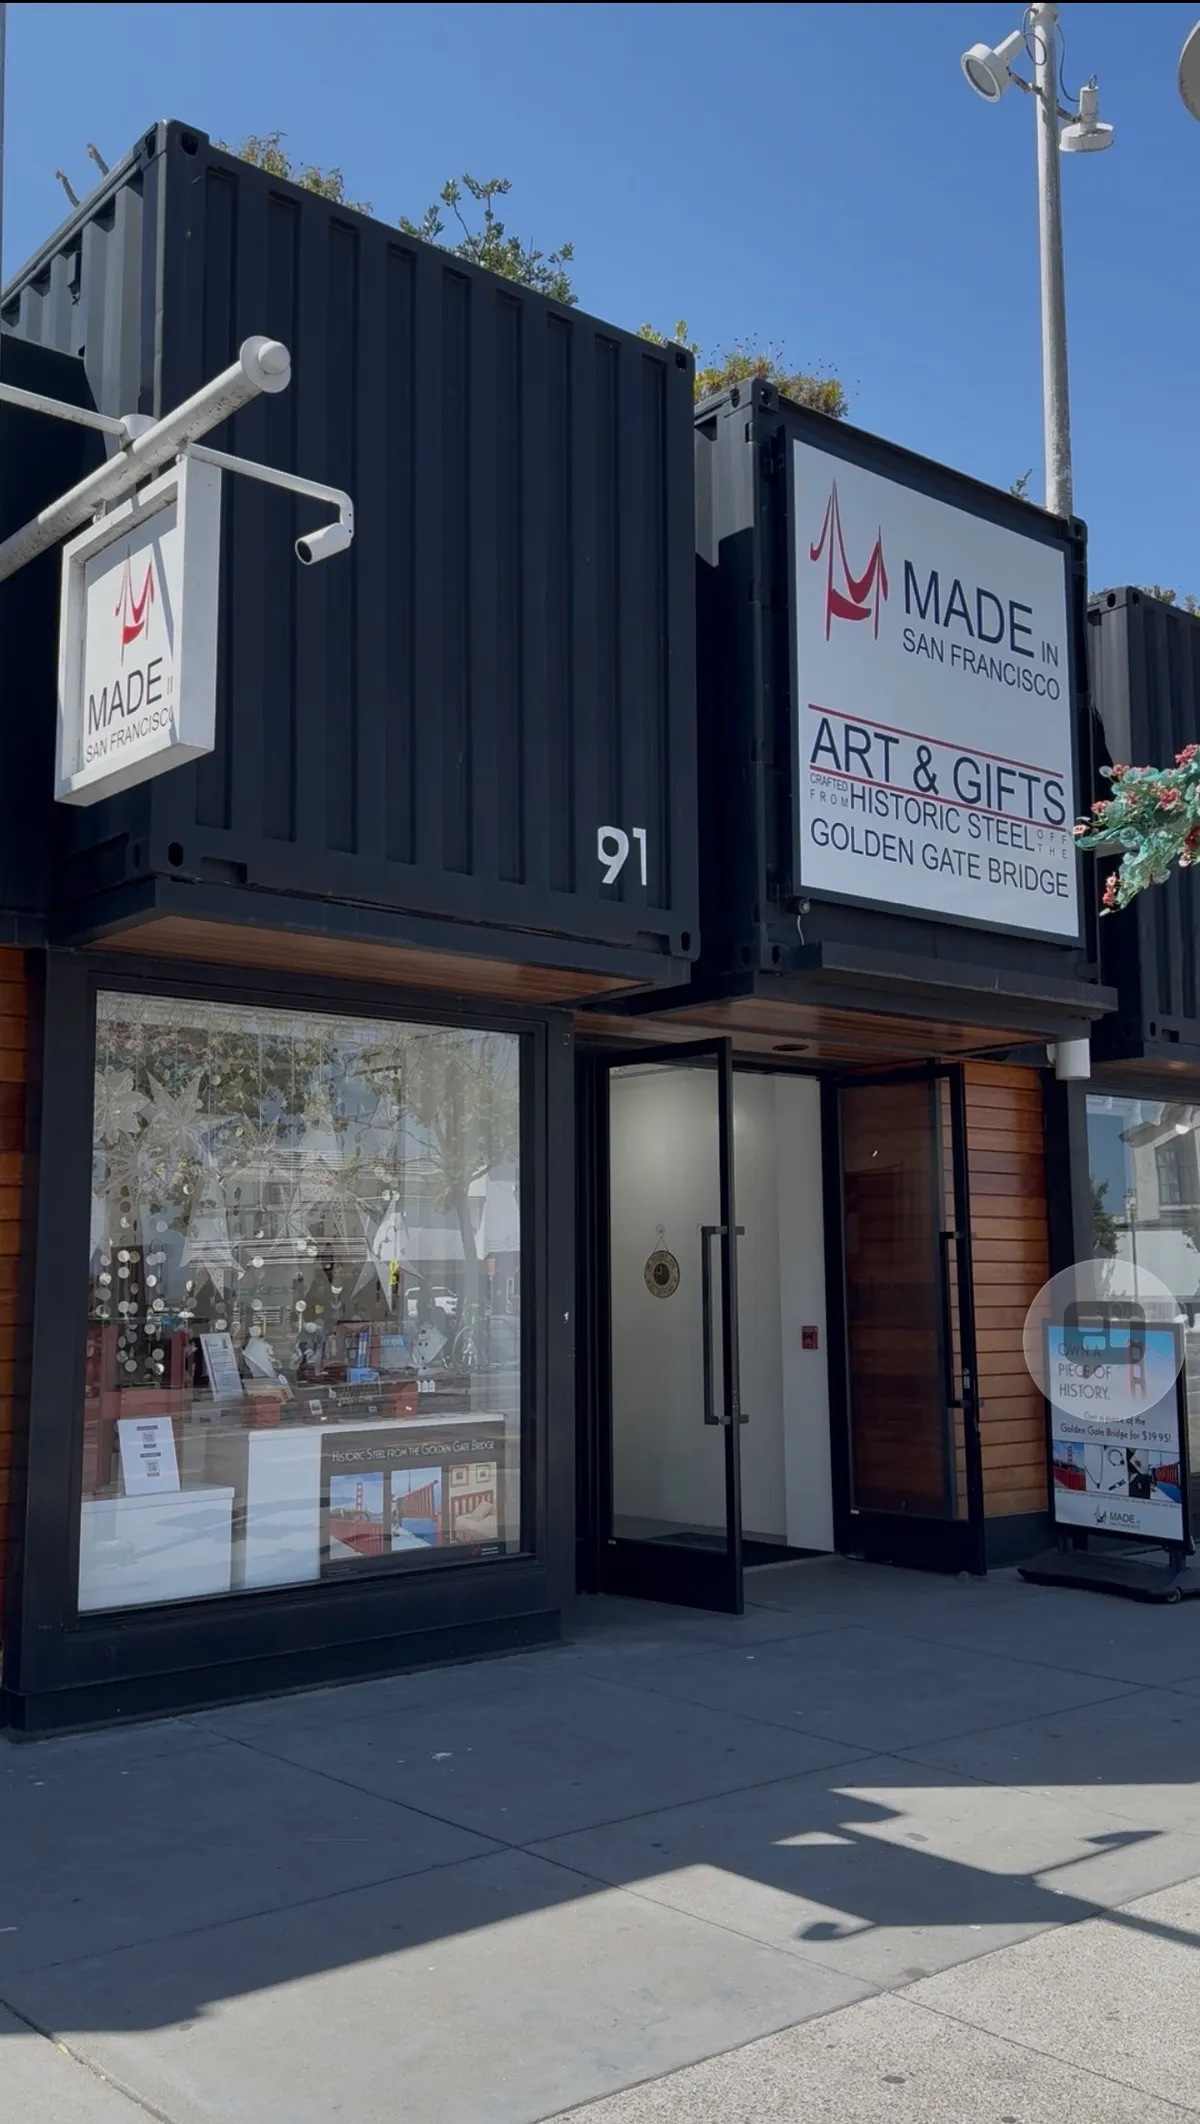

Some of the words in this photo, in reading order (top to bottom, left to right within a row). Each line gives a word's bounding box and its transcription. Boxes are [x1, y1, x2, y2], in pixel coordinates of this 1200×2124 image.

[904, 559, 1035, 659] MADE
[1041, 641, 1059, 668] IN
[902, 628, 944, 663] SAN
[951, 644, 1060, 700] FRANCISCO
[88, 657, 163, 735] MADE
[86, 737, 108, 763] SAN
[810, 717, 899, 783] ART
[913, 744, 940, 795] &
[953, 756, 1067, 825] GIFTS
[810, 772, 848, 792] CRAFTED
[810, 788, 849, 808] FROM
[850, 782, 961, 835] HISTORIC
[967, 813, 1036, 853] STEEL
[1037, 829, 1068, 845] OFF
[597, 825, 647, 887] 91
[810, 818, 914, 866] GOLDEN
[921, 843, 982, 881] GATE
[988, 857, 1069, 899] BRIDGE
[1037, 843, 1068, 860] THE
[1058, 1363, 1090, 1377] PIECE
[1093, 1364, 1112, 1379] OF
[1060, 1422, 1086, 1434] Golden
[1087, 1425, 1105, 1437] Gate
[1106, 1428, 1128, 1440] Bridge
[1129, 1430, 1140, 1441] for
[1109, 1511, 1136, 1524] MADE
